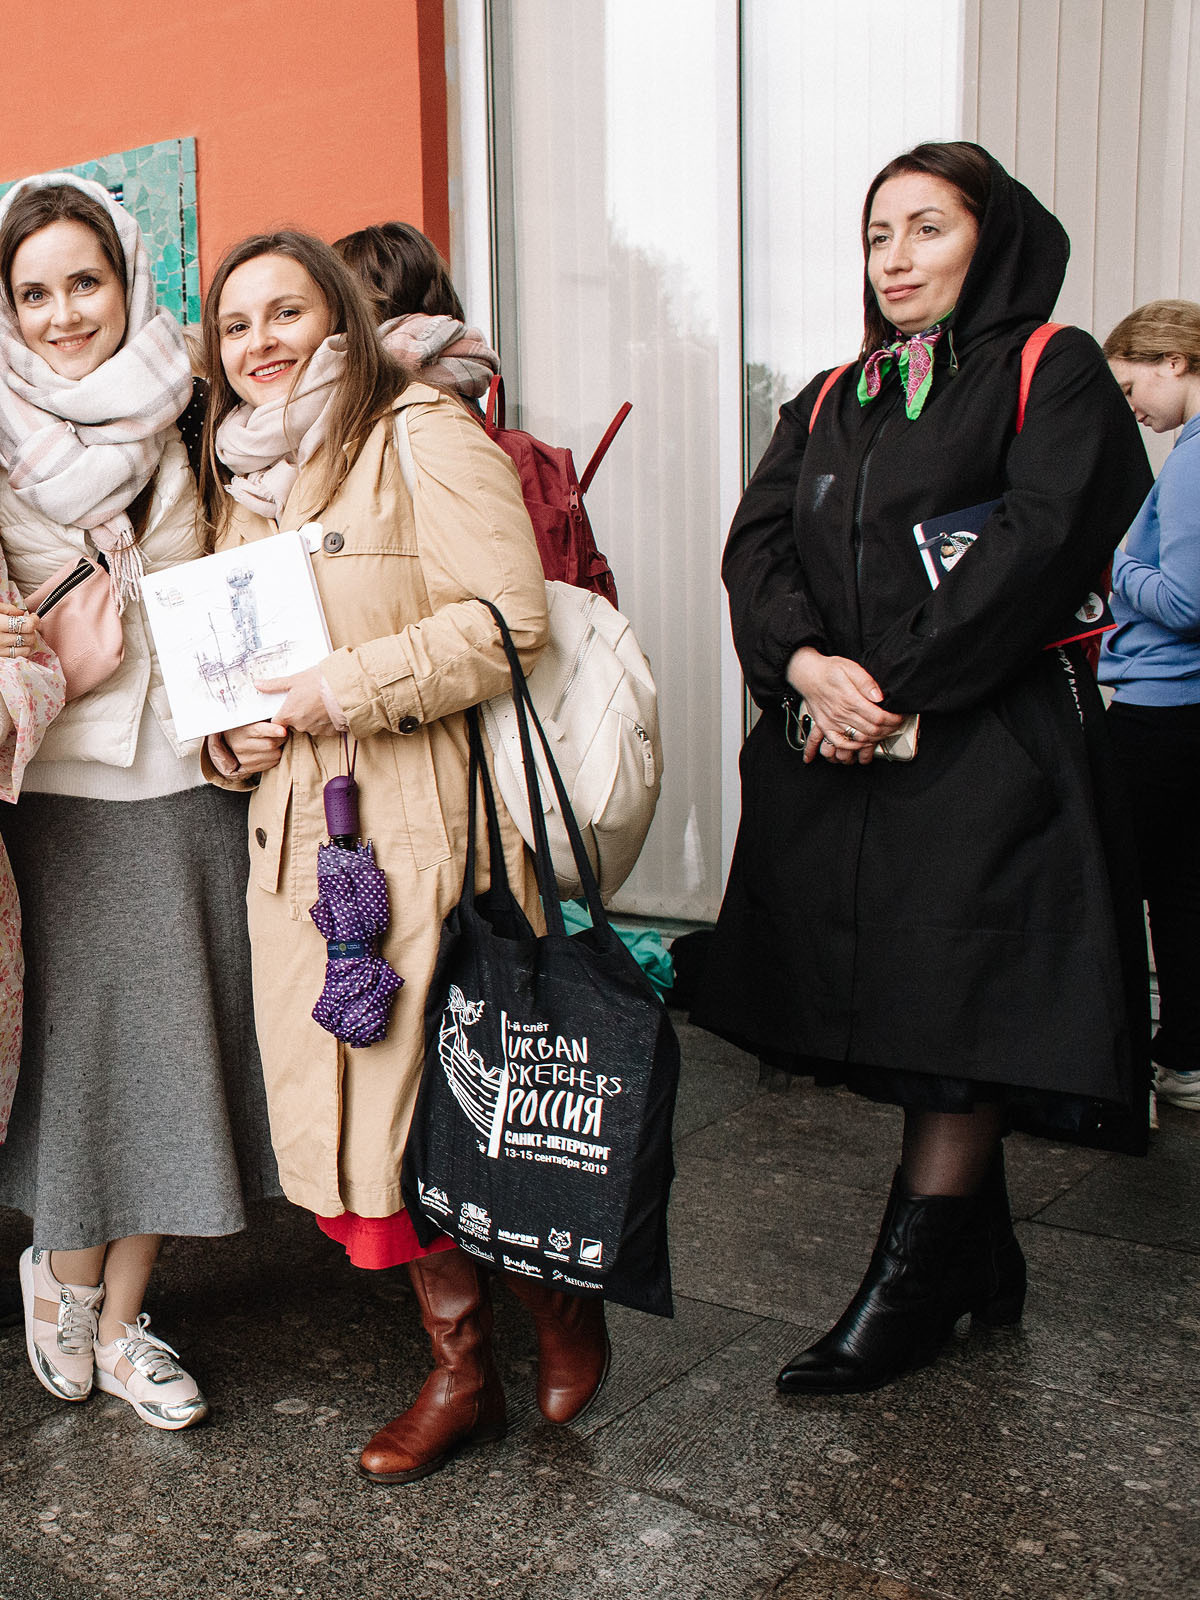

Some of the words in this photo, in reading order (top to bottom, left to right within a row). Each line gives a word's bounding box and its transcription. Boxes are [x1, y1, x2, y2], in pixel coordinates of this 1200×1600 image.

[522, 1022, 550, 1033] слёт
[508, 1035, 588, 1064] URBAN
[509, 1062, 622, 1097] SKETCHERS
[506, 1088, 604, 1137] РОССИЯ
[504, 1130, 612, 1161] САНКТ-ПЕТЕРБУРГ
[504, 1147, 534, 1160] 13-15
[534, 1153, 581, 1169] сентября
[581, 1161, 608, 1175] 2019
[458, 1223, 490, 1242] NEWTON
[460, 1215, 489, 1236] WINSOR
